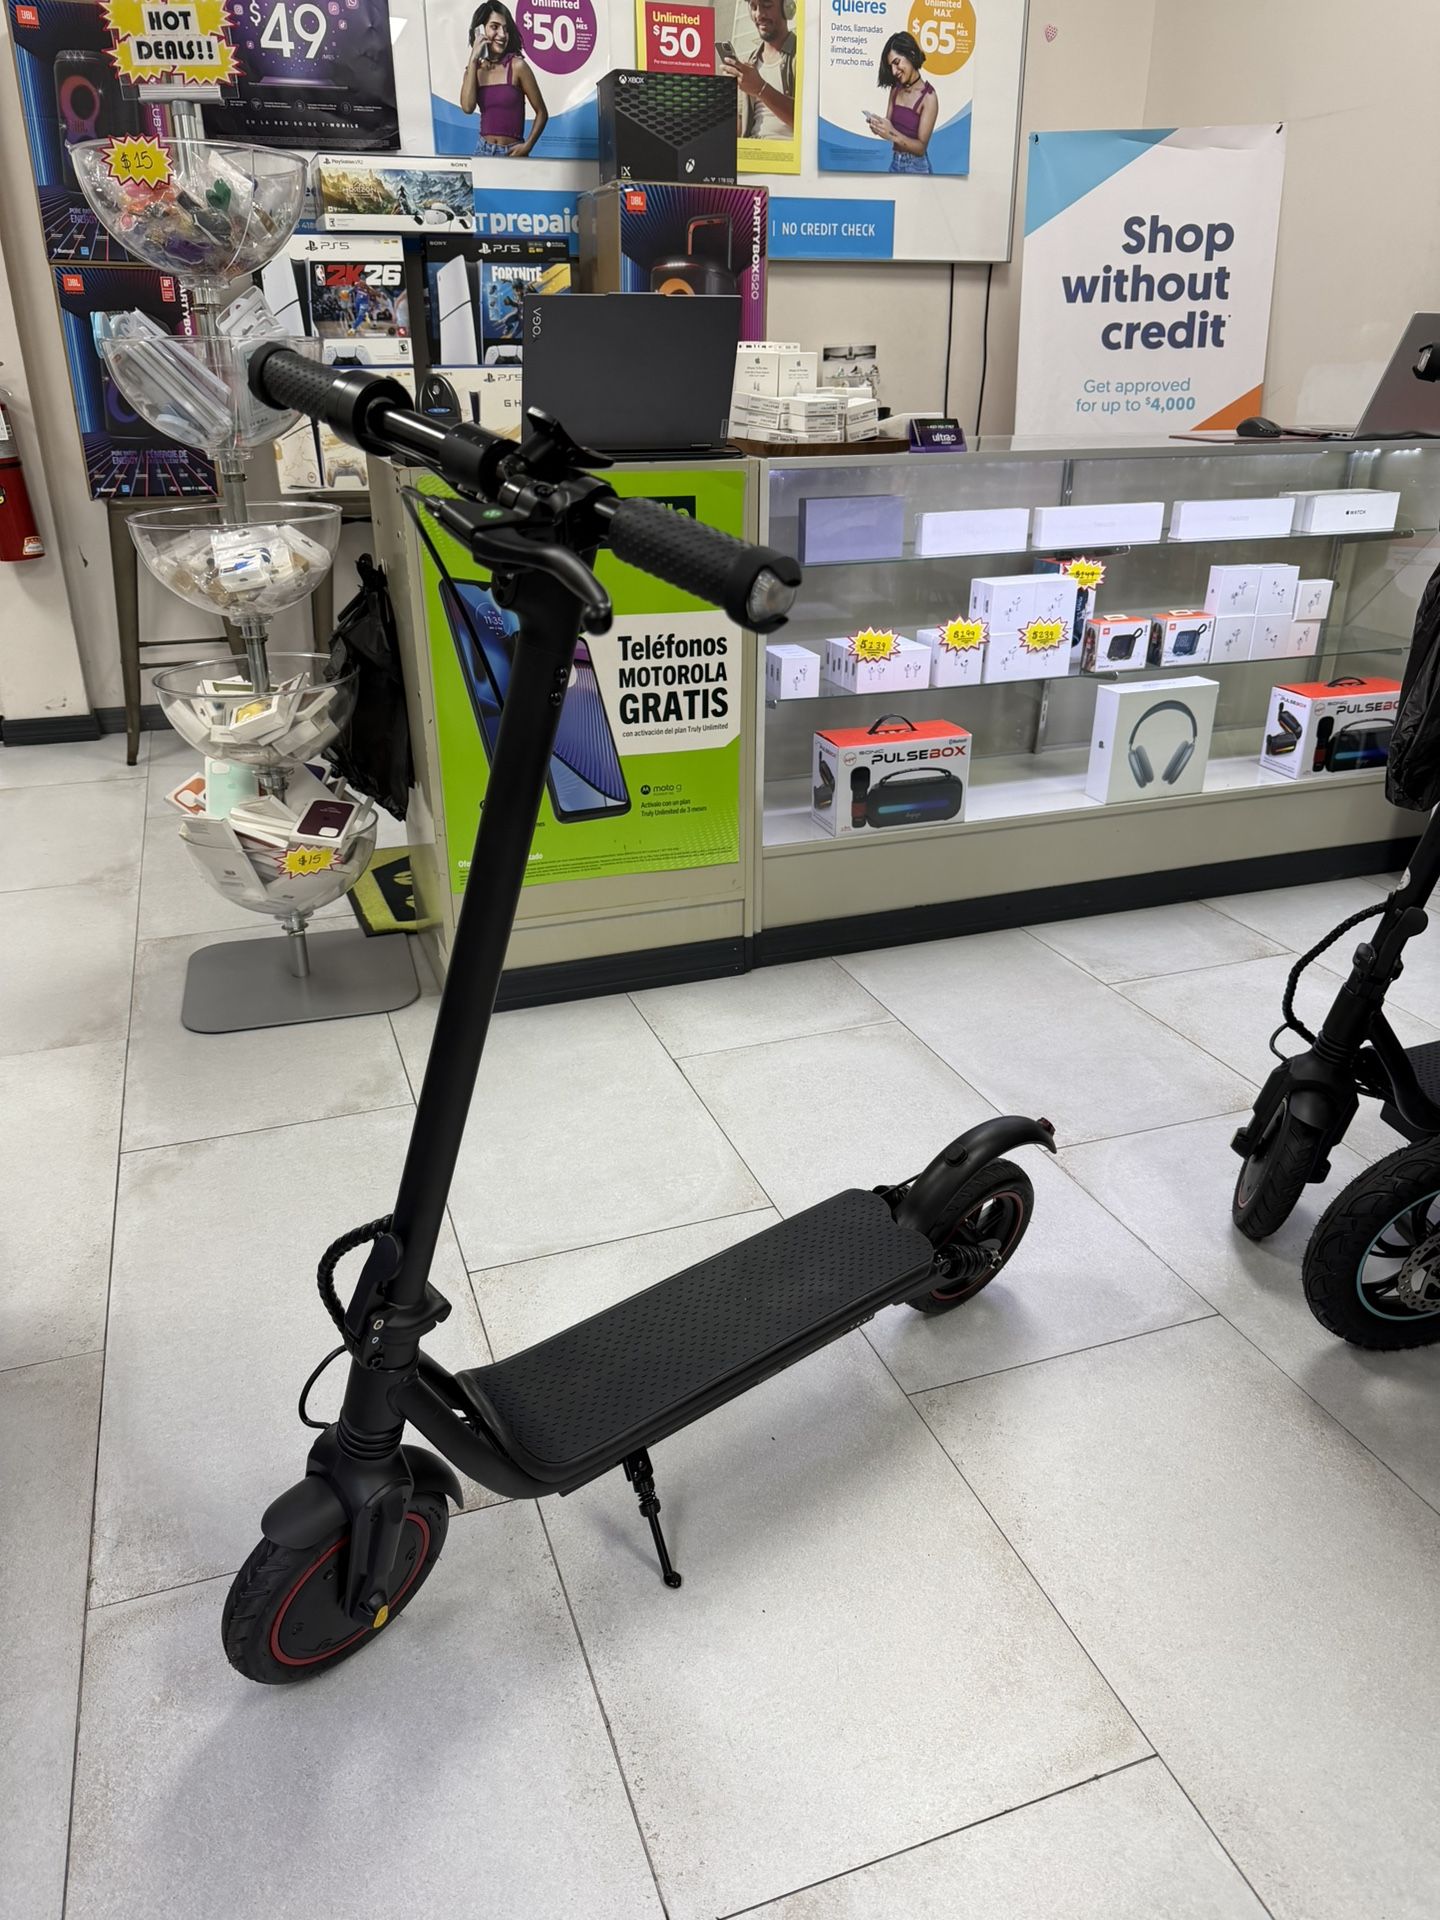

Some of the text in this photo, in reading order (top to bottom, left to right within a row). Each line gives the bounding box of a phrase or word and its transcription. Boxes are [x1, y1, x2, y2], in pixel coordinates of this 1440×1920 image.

[531, 0, 580, 10] Unlimited
[832, 0, 887, 16] quieres
[924, 0, 962, 9] Unlimited
[148, 10, 191, 31] HOT
[652, 10, 700, 26] Unlimited
[933, 8, 953, 18] MAX
[250, 0, 327, 59] $49
[523, 11, 576, 52] $50
[831, 22, 884, 34] Datos, llamadas
[912, 17, 956, 55] $65
[652, 24, 702, 59] $50
[830, 35, 868, 46] y mensajes
[136, 39, 215, 61] DEALS!!
[830, 56, 874, 67] y mucho más
[627, 76, 645, 84] XBOX
[120, 151, 153, 172] $15
[630, 195, 644, 207] JBL
[781, 222, 876, 238] NO CREDIT CHECK
[1121, 214, 1235, 262] Shop
[320, 241, 350, 250] PS5
[492, 243, 521, 254] PS5
[325, 263, 402, 286] 2K26
[490, 265, 543, 282] FORTNITE
[1061, 264, 1231, 304] without
[1100, 309, 1227, 351] credit
[497, 373, 523, 382] PS5
[1083, 377, 1191, 398] Get approved
[1075, 395, 1196, 415] for up to $4,000
[617, 633, 728, 662] Teléfonos
[618, 661, 728, 689] MOTOROLA
[618, 687, 729, 725] GRATIS
[1335, 700, 1400, 715] PULSEBO
[634, 728, 664, 737] activación
[664, 727, 674, 735] del
[674, 727, 687, 736] plan
[687, 725, 701, 734] Truly
[702, 722, 729, 732] Unlimited
[858, 748, 885, 756] SONIC
[871, 745, 966, 765] PULSEBOX
[652, 783, 683, 793] moto g
[654, 808, 680, 817] Unlimited
[297, 854, 322, 867] $15
